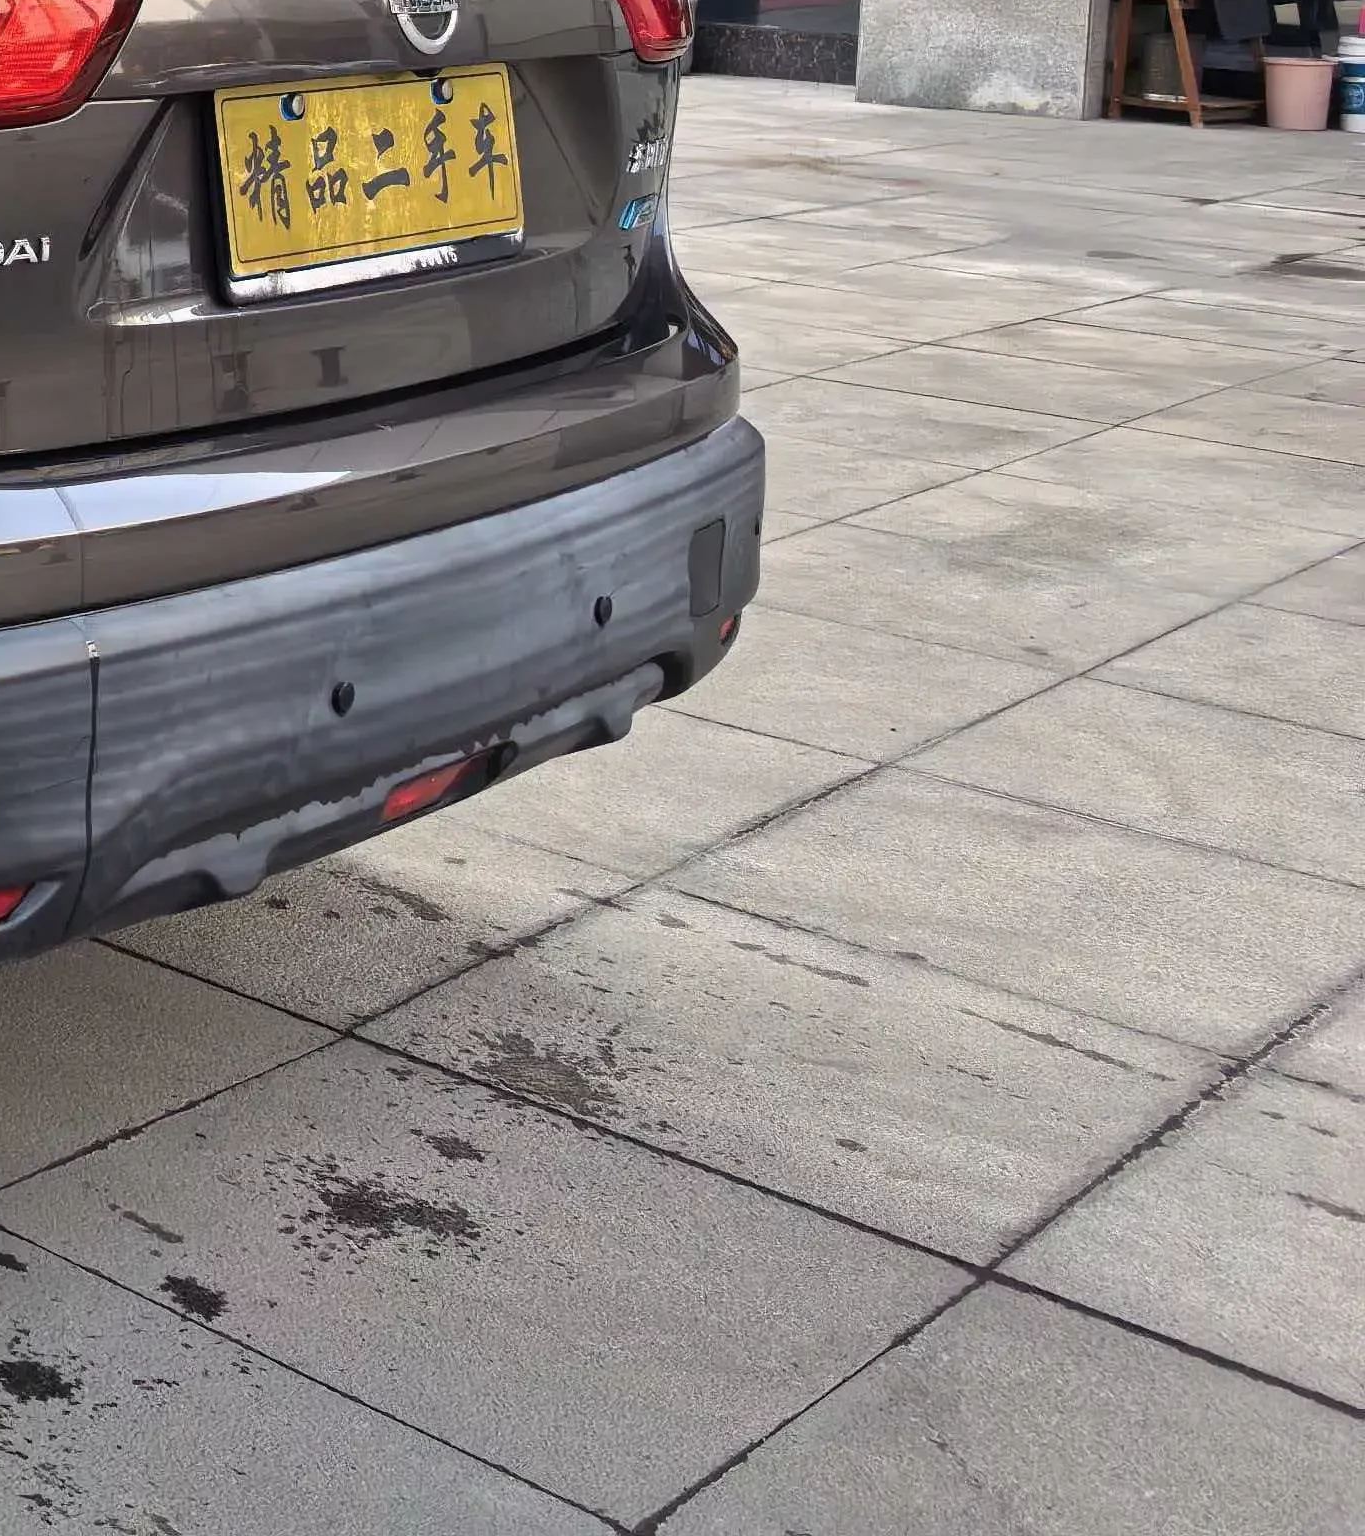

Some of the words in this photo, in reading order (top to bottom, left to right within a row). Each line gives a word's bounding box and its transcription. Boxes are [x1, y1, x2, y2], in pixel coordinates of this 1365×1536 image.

[240, 103, 509, 229] 精品二手车
